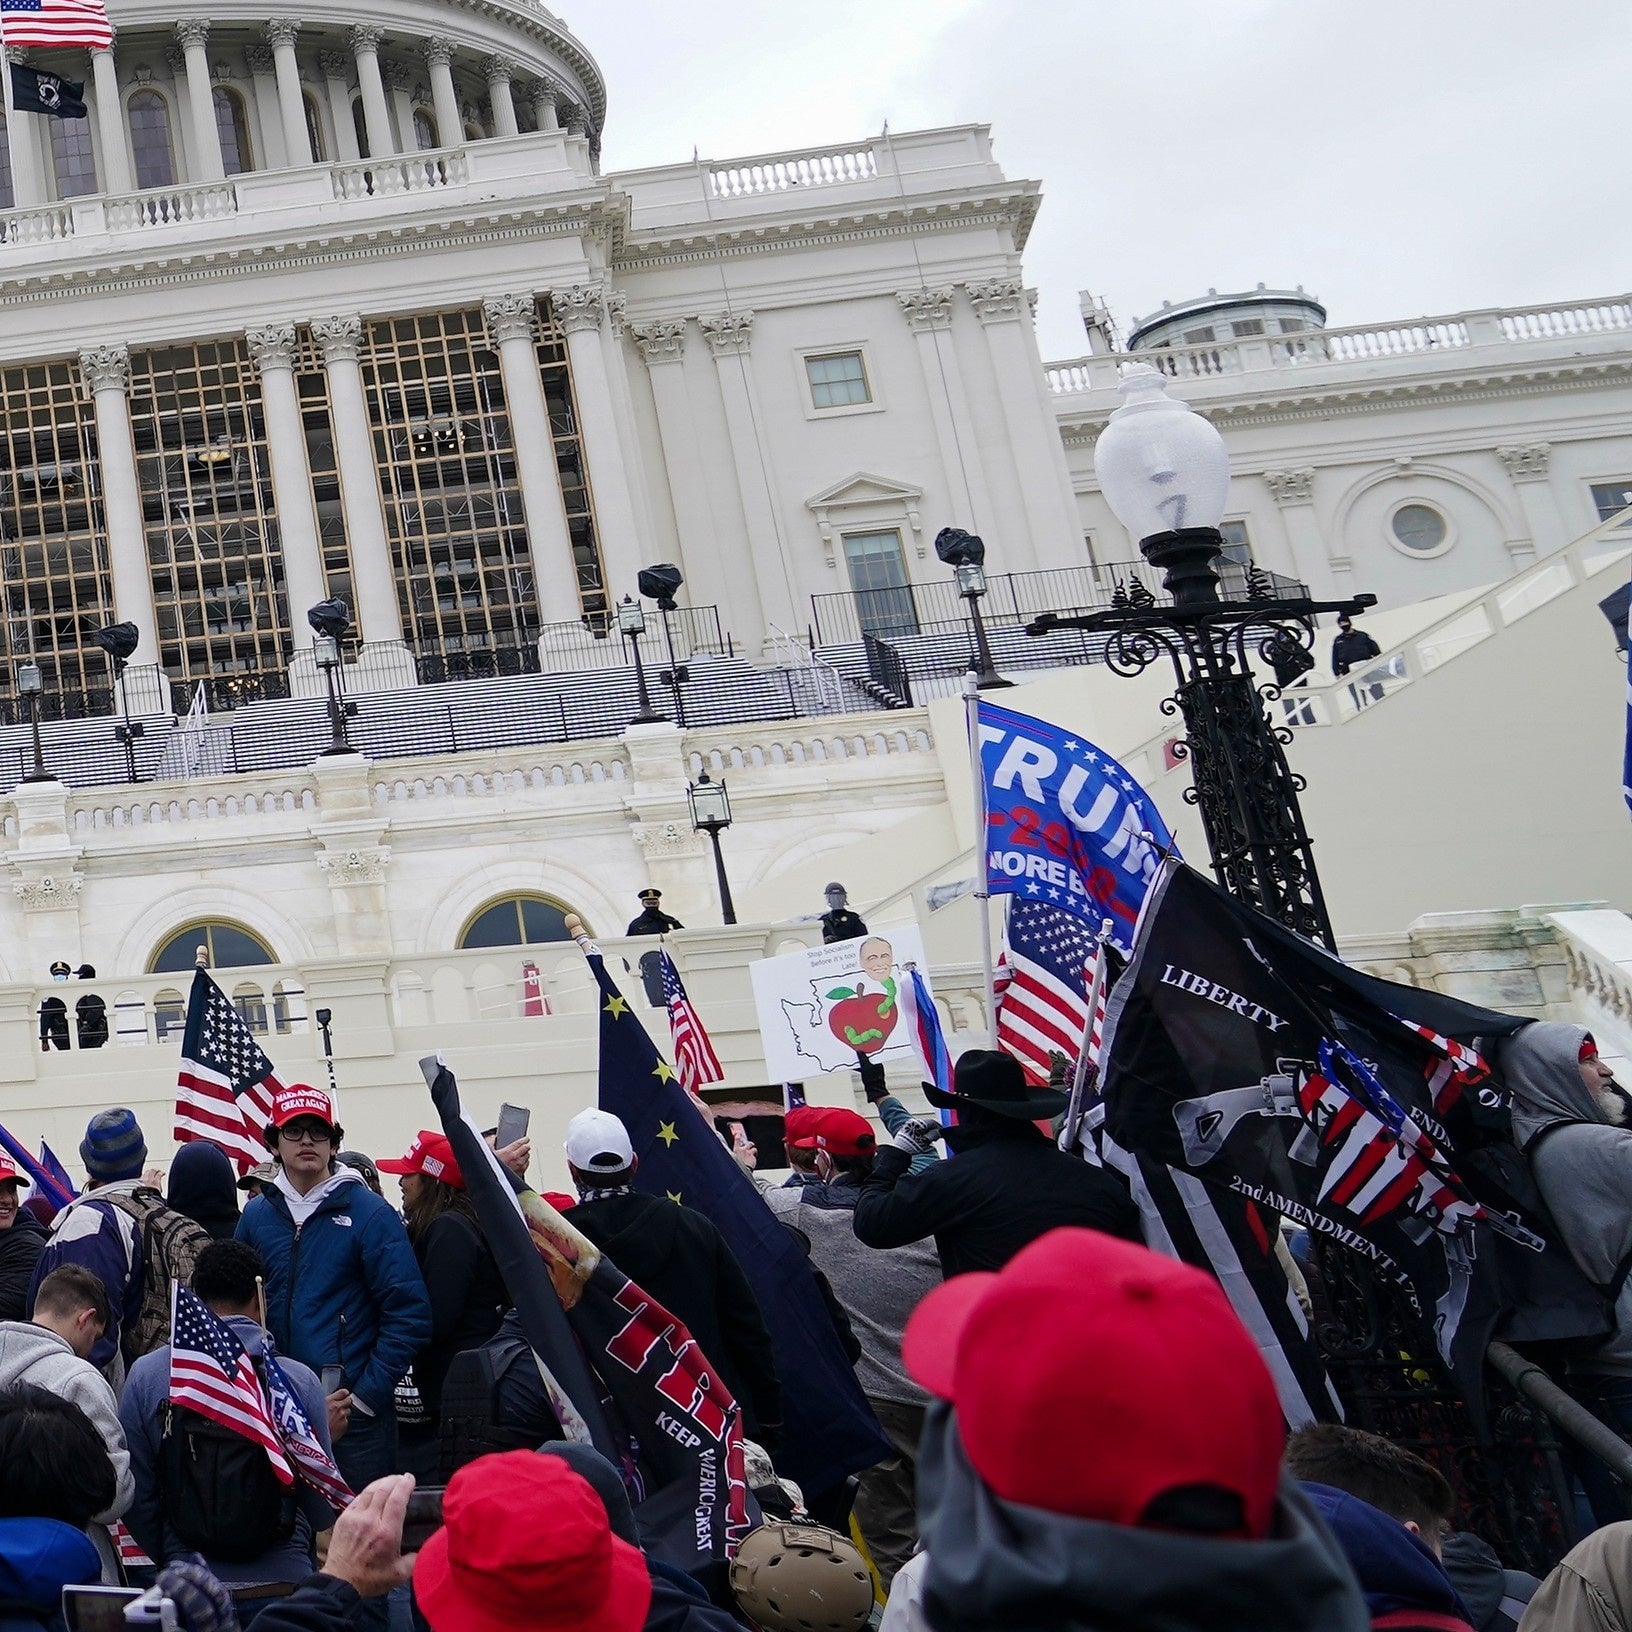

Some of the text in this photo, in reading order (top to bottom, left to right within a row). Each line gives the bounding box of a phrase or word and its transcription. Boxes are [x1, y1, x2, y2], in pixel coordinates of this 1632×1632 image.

[1161, 964, 1290, 1033] LIBERTY
[281, 1098, 304, 1112] GREAT
[1229, 1174, 1263, 1202] 2nd
[1265, 1191, 1397, 1270] AMENDMENT
[655, 1411, 702, 1449] KEEP
[694, 1504, 713, 1552] GREAT
